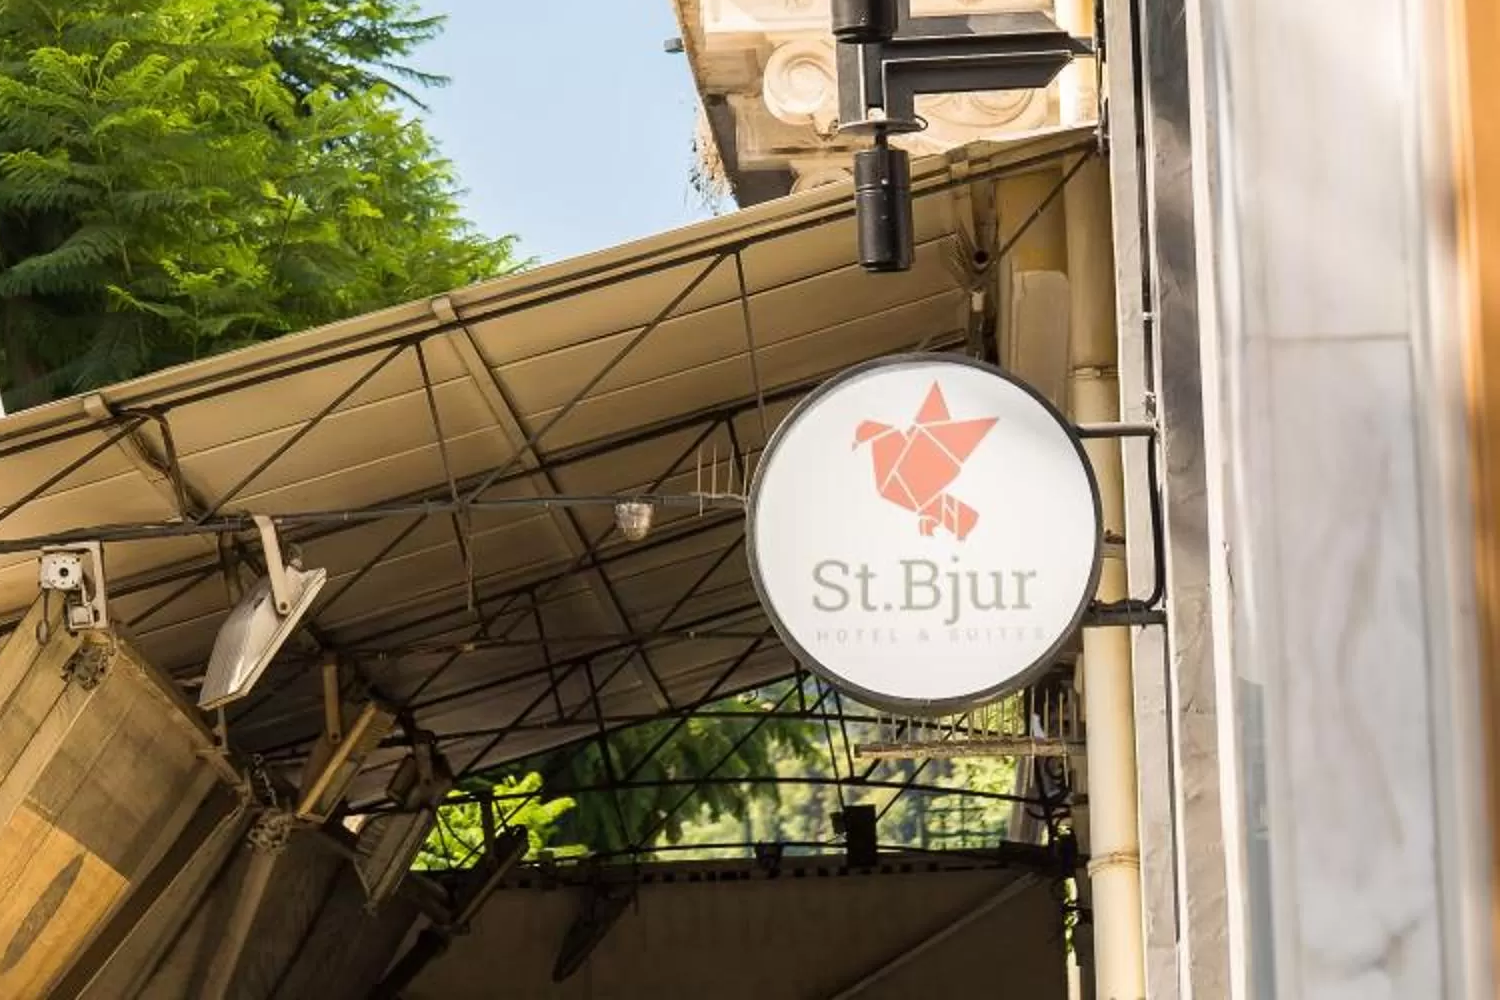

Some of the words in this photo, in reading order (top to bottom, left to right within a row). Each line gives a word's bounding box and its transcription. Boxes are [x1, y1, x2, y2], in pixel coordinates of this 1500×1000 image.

[811, 555, 1038, 627] St.Bjur
[816, 627, 899, 645] HOTEL
[918, 627, 931, 643] &
[950, 627, 1045, 643] SUITES
